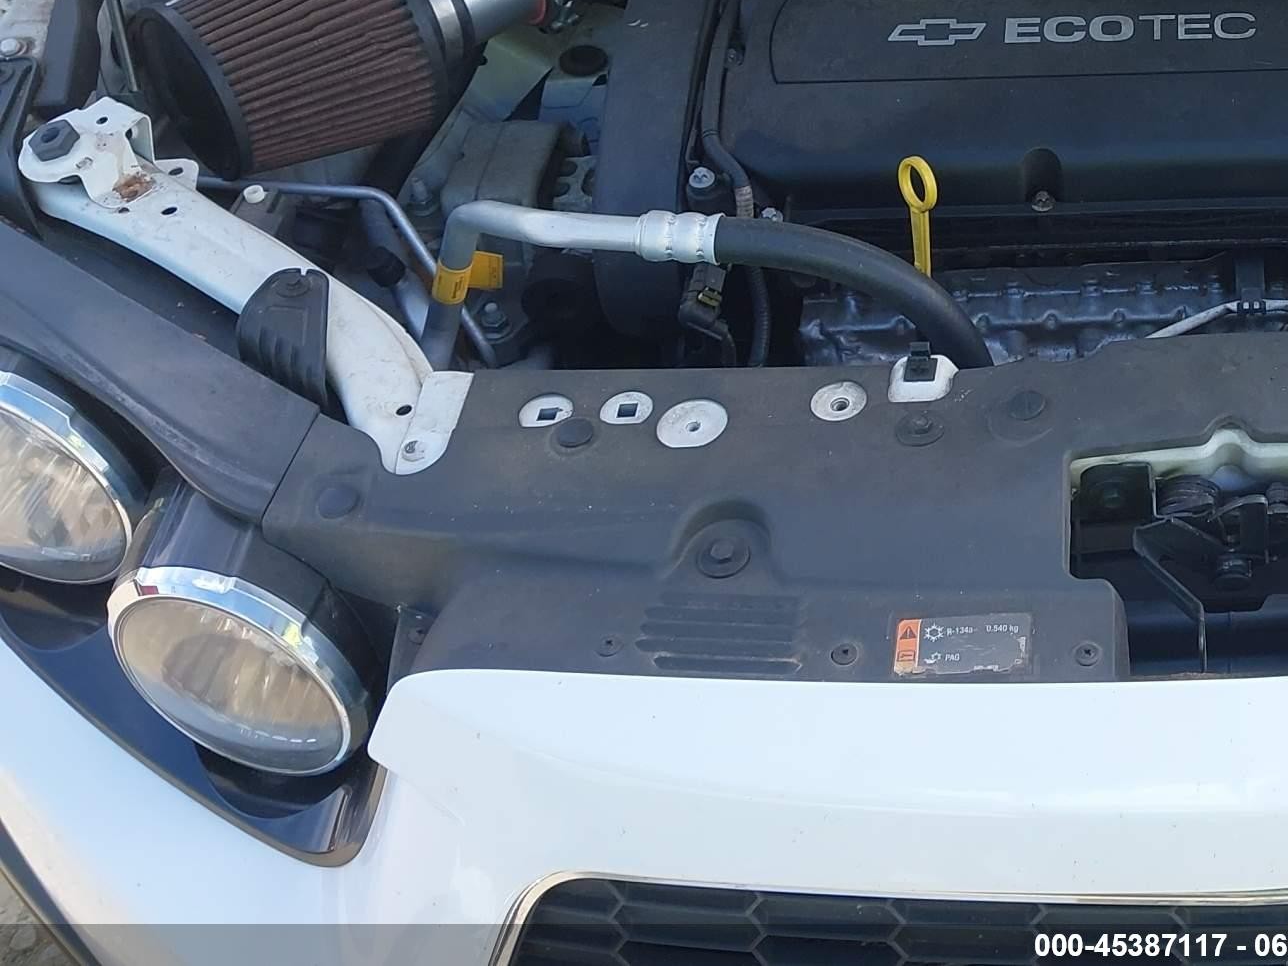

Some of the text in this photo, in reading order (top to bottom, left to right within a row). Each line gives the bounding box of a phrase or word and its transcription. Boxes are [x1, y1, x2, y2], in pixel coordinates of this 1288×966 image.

[1004, 12, 1256, 43] ECOTEC
[986, 624, 1008, 632] 0.540
[1009, 624, 1019, 633] kg
[945, 653, 960, 661] PAG
